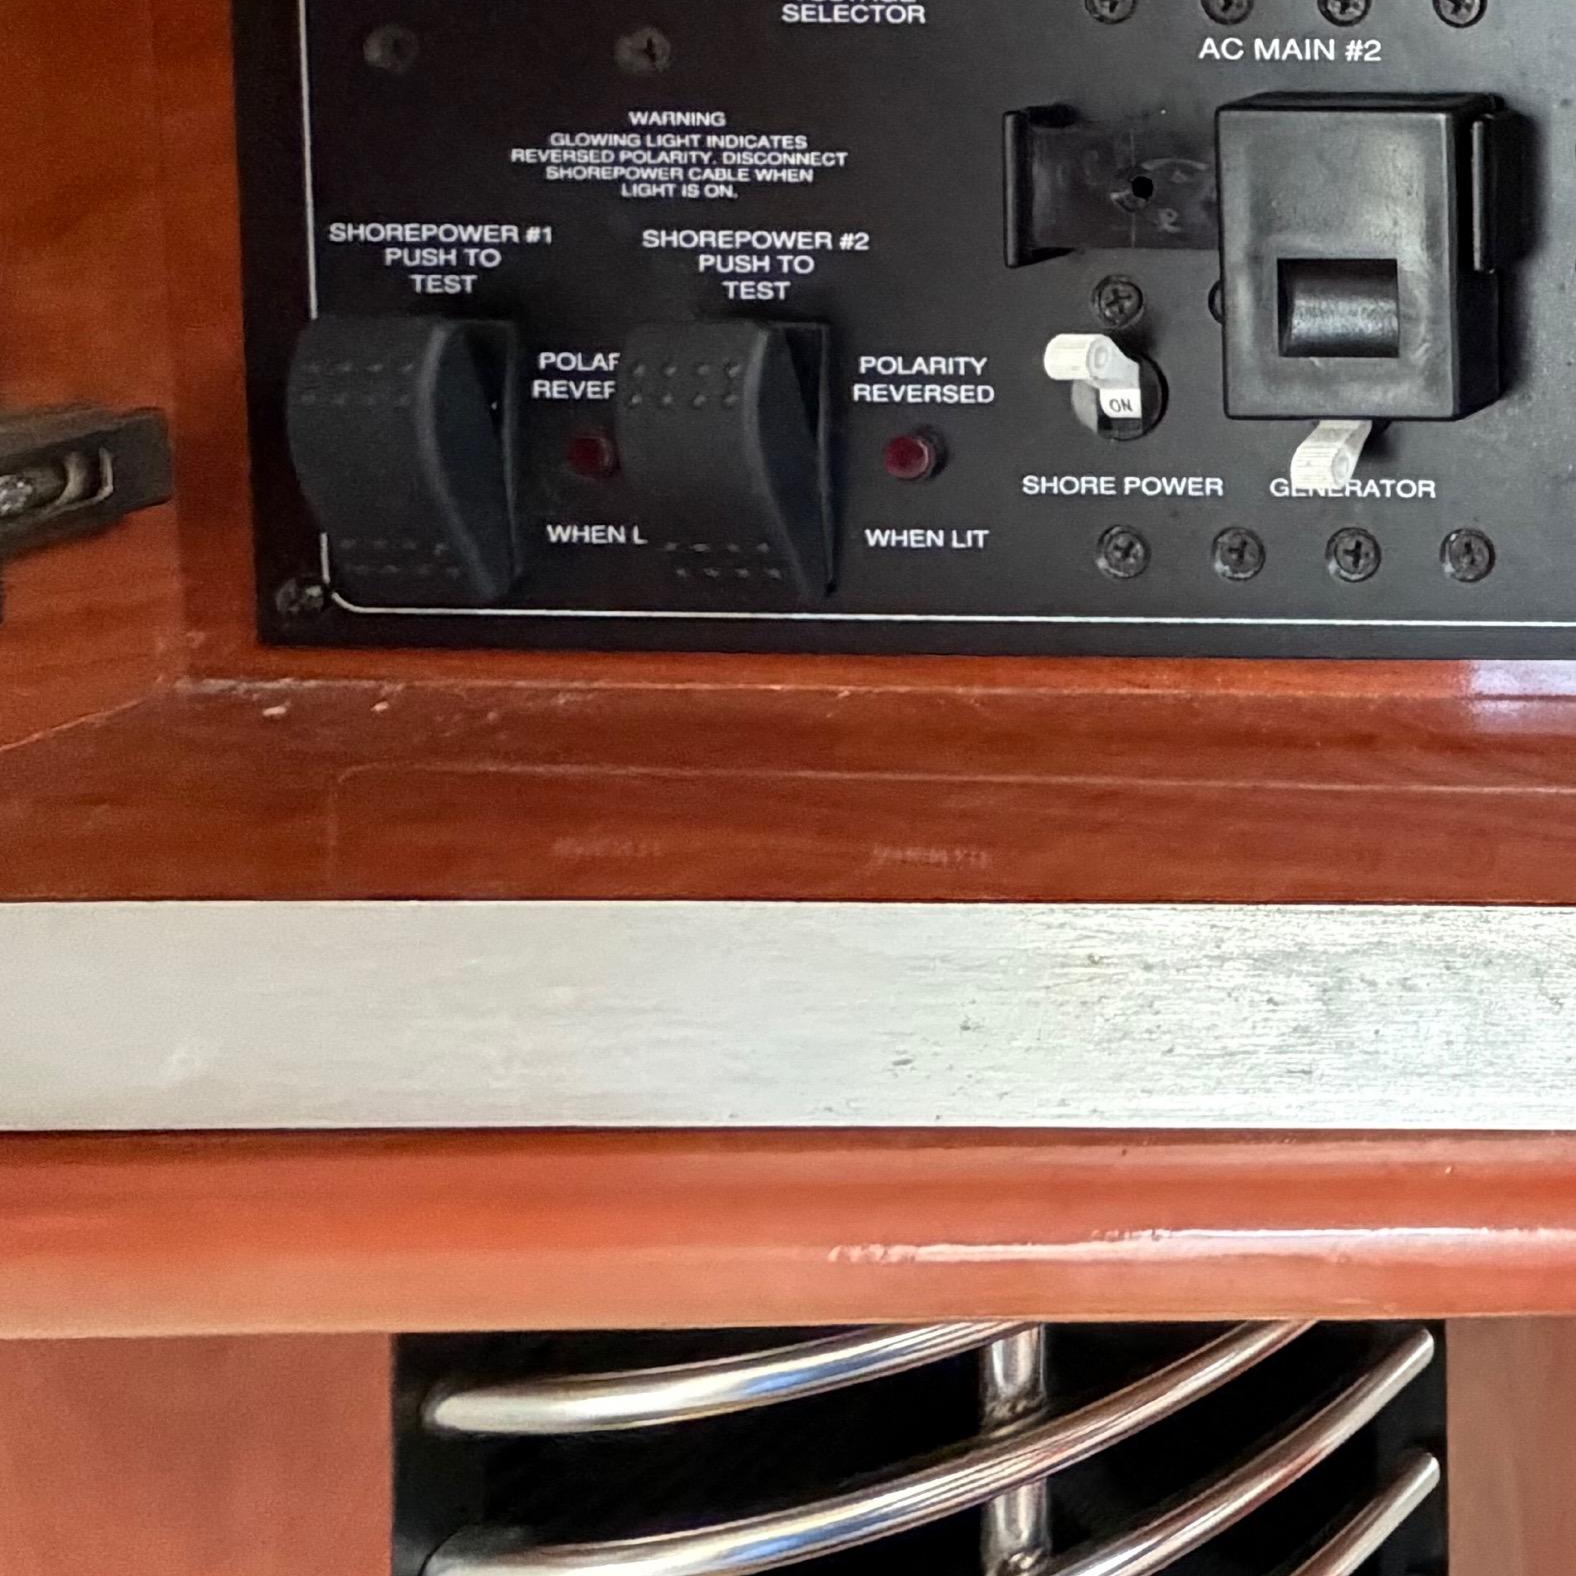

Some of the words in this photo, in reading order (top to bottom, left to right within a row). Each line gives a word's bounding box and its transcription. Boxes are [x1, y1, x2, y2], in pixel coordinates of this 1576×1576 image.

[781, 3, 927, 24] SELECTOR
[1198, 36, 1245, 60] AC
[1253, 37, 1336, 61] MAIN
[1344, 38, 1382, 62] #2
[627, 110, 727, 127] WARNING
[549, 132, 642, 147] GLOWING
[645, 133, 702, 148] LIGHT
[705, 134, 809, 150] INDICATES
[328, 222, 520, 243] SHOREPOWER
[524, 225, 553, 243] #1
[642, 229, 834, 250] SHOREPOWER
[838, 231, 870, 251] #2
[384, 247, 458, 267] PUSH
[462, 247, 503, 268] TO
[698, 253, 771, 273] PUSH
[776, 254, 816, 274] TO
[408, 273, 478, 294] TEST
[721, 280, 792, 300] TEST
[859, 355, 988, 375] POLARITY
[852, 383, 996, 404] REVERSED
[1022, 475, 1118, 495] SHORE
[1123, 476, 1224, 496] POWER
[864, 528, 945, 548] WHEN
[950, 529, 990, 548] LIT
